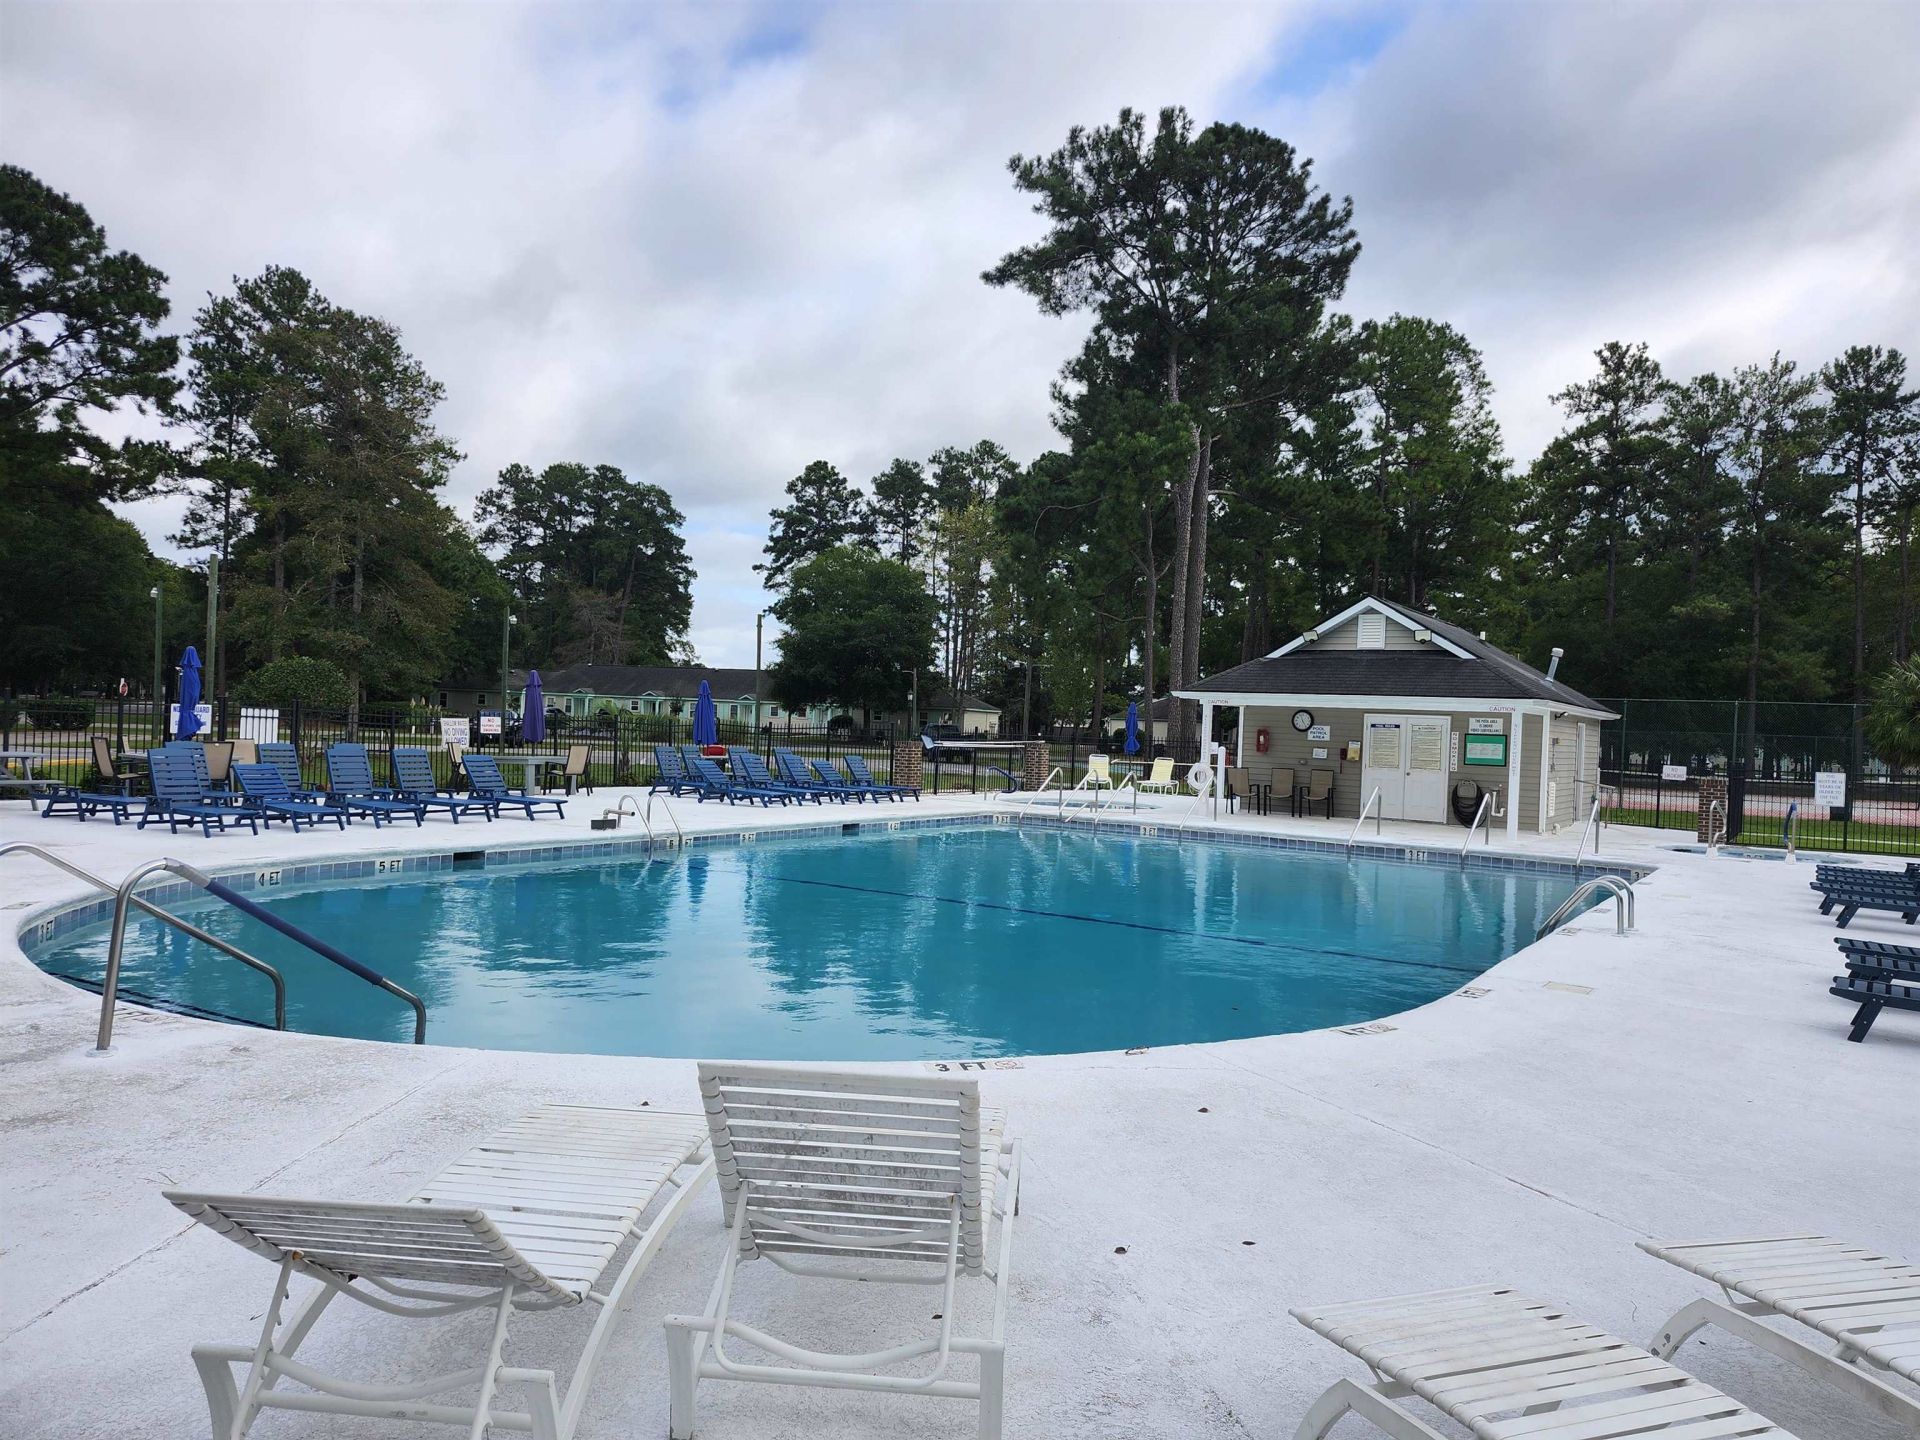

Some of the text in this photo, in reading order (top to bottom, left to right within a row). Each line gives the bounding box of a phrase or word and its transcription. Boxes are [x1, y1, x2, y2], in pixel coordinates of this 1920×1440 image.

[444, 727, 468, 736] NO DIVING
[1416, 850, 1426, 861] FT
[379, 861, 386, 873] 5
[1634, 871, 1640, 880] 3
[934, 1061, 987, 1072] 3 FT
